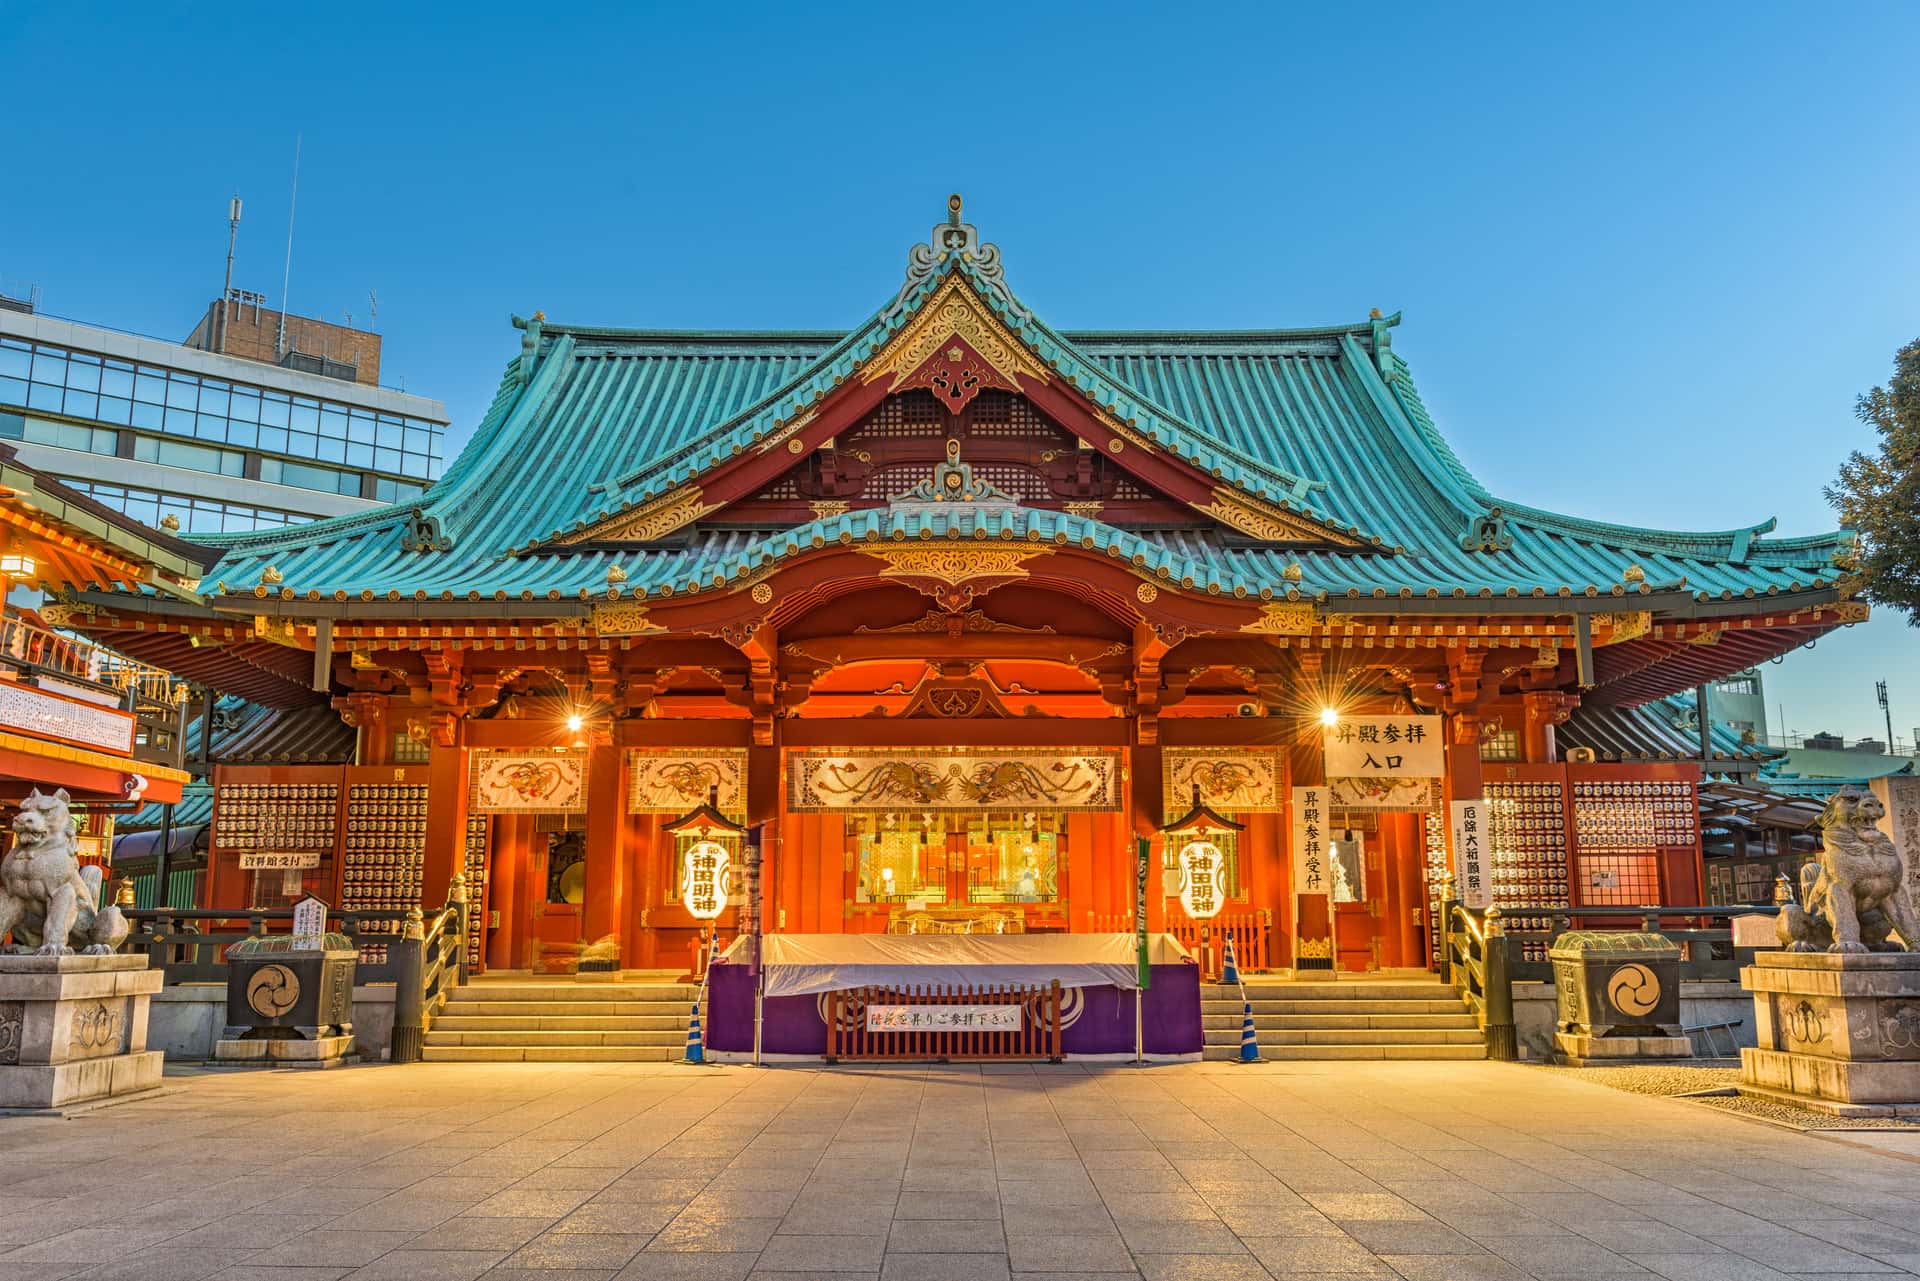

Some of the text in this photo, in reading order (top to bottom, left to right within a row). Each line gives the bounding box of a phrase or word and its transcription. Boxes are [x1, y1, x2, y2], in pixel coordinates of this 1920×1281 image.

[1336, 723, 1427, 744] 昇殿参拝
[1361, 752, 1403, 769] 入口
[244, 855, 300, 867] 資料館受付
[1303, 791, 1321, 890] 昇殿参拝受付
[1463, 806, 1481, 888] 厄除大祈願祭
[692, 854, 717, 911] 神田明神
[1188, 856, 1214, 911] 神田明神
